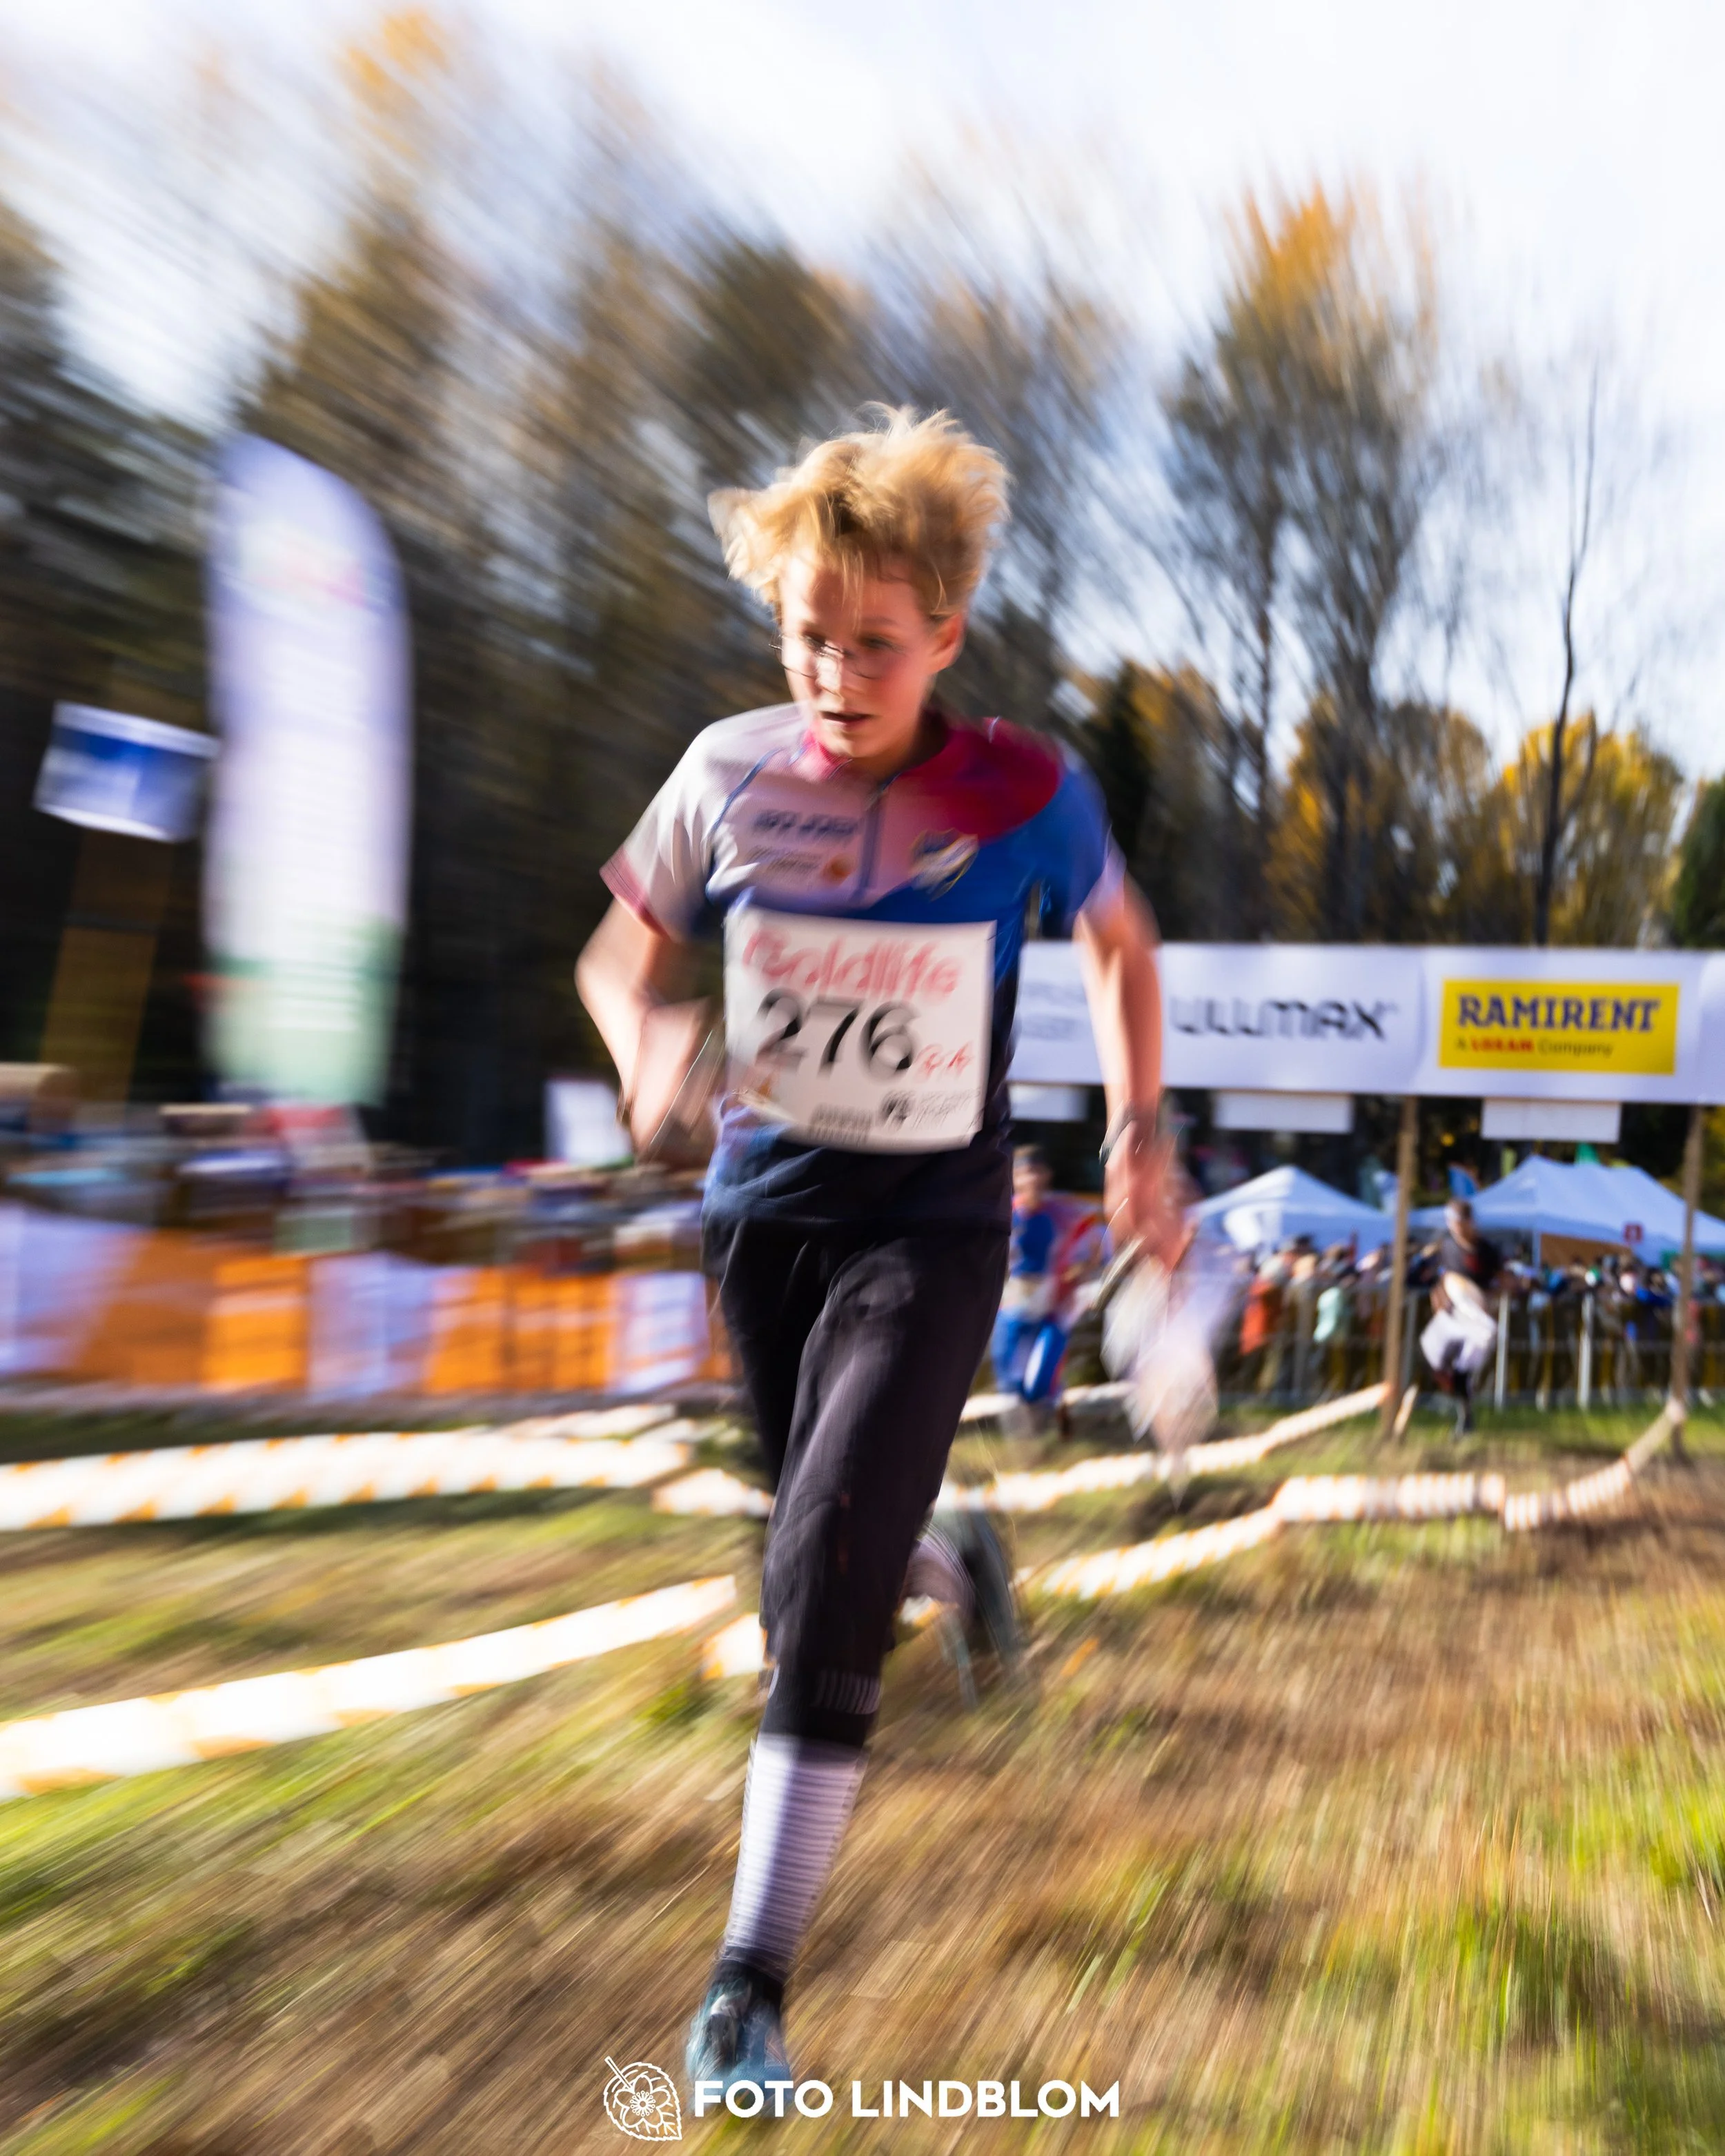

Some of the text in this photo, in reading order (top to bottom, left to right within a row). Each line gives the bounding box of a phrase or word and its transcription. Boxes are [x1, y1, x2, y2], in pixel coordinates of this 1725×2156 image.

[1457, 992, 1661, 1033] RAMIRENT
[757, 987, 919, 1083] 276
[1537, 1038, 1615, 1058] Company
